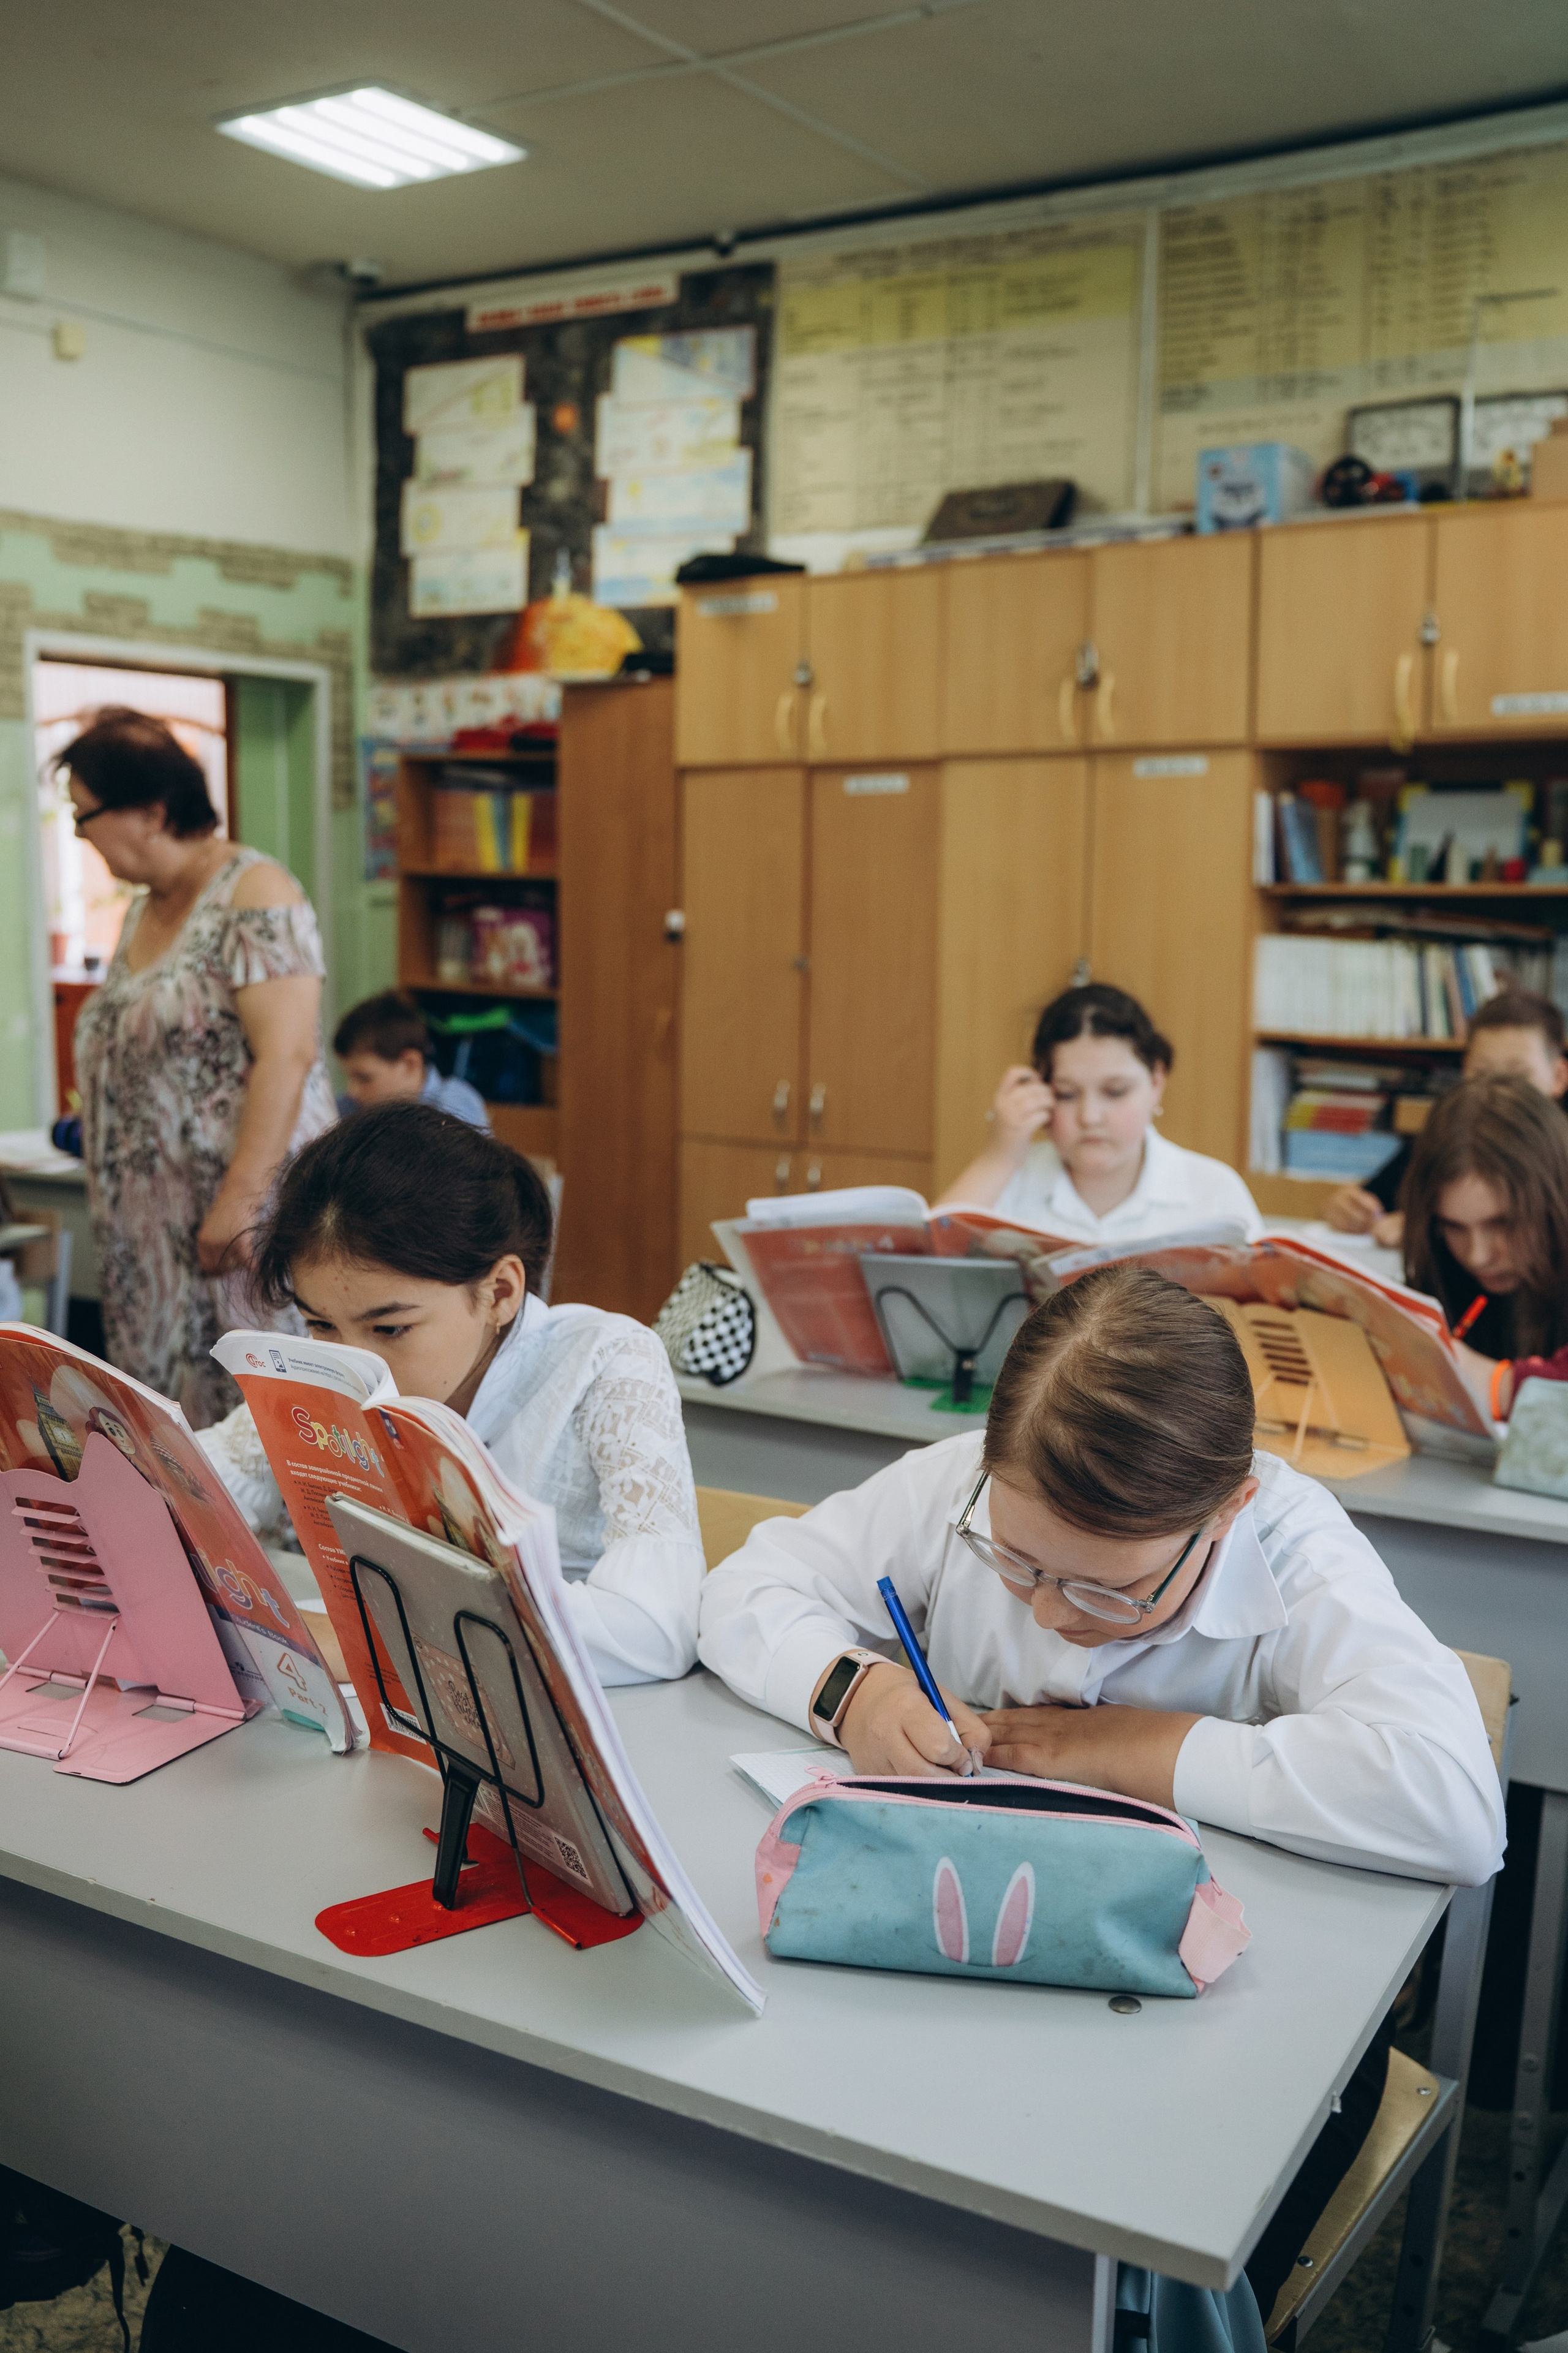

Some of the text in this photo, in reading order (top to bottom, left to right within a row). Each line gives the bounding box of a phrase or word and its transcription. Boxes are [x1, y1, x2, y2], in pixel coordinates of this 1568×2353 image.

[291, 1407, 385, 1478] Spotlight
[318, 1543, 336, 1554] Состав
[277, 1652, 307, 1691] 4
[288, 1686, 318, 1709] Part
